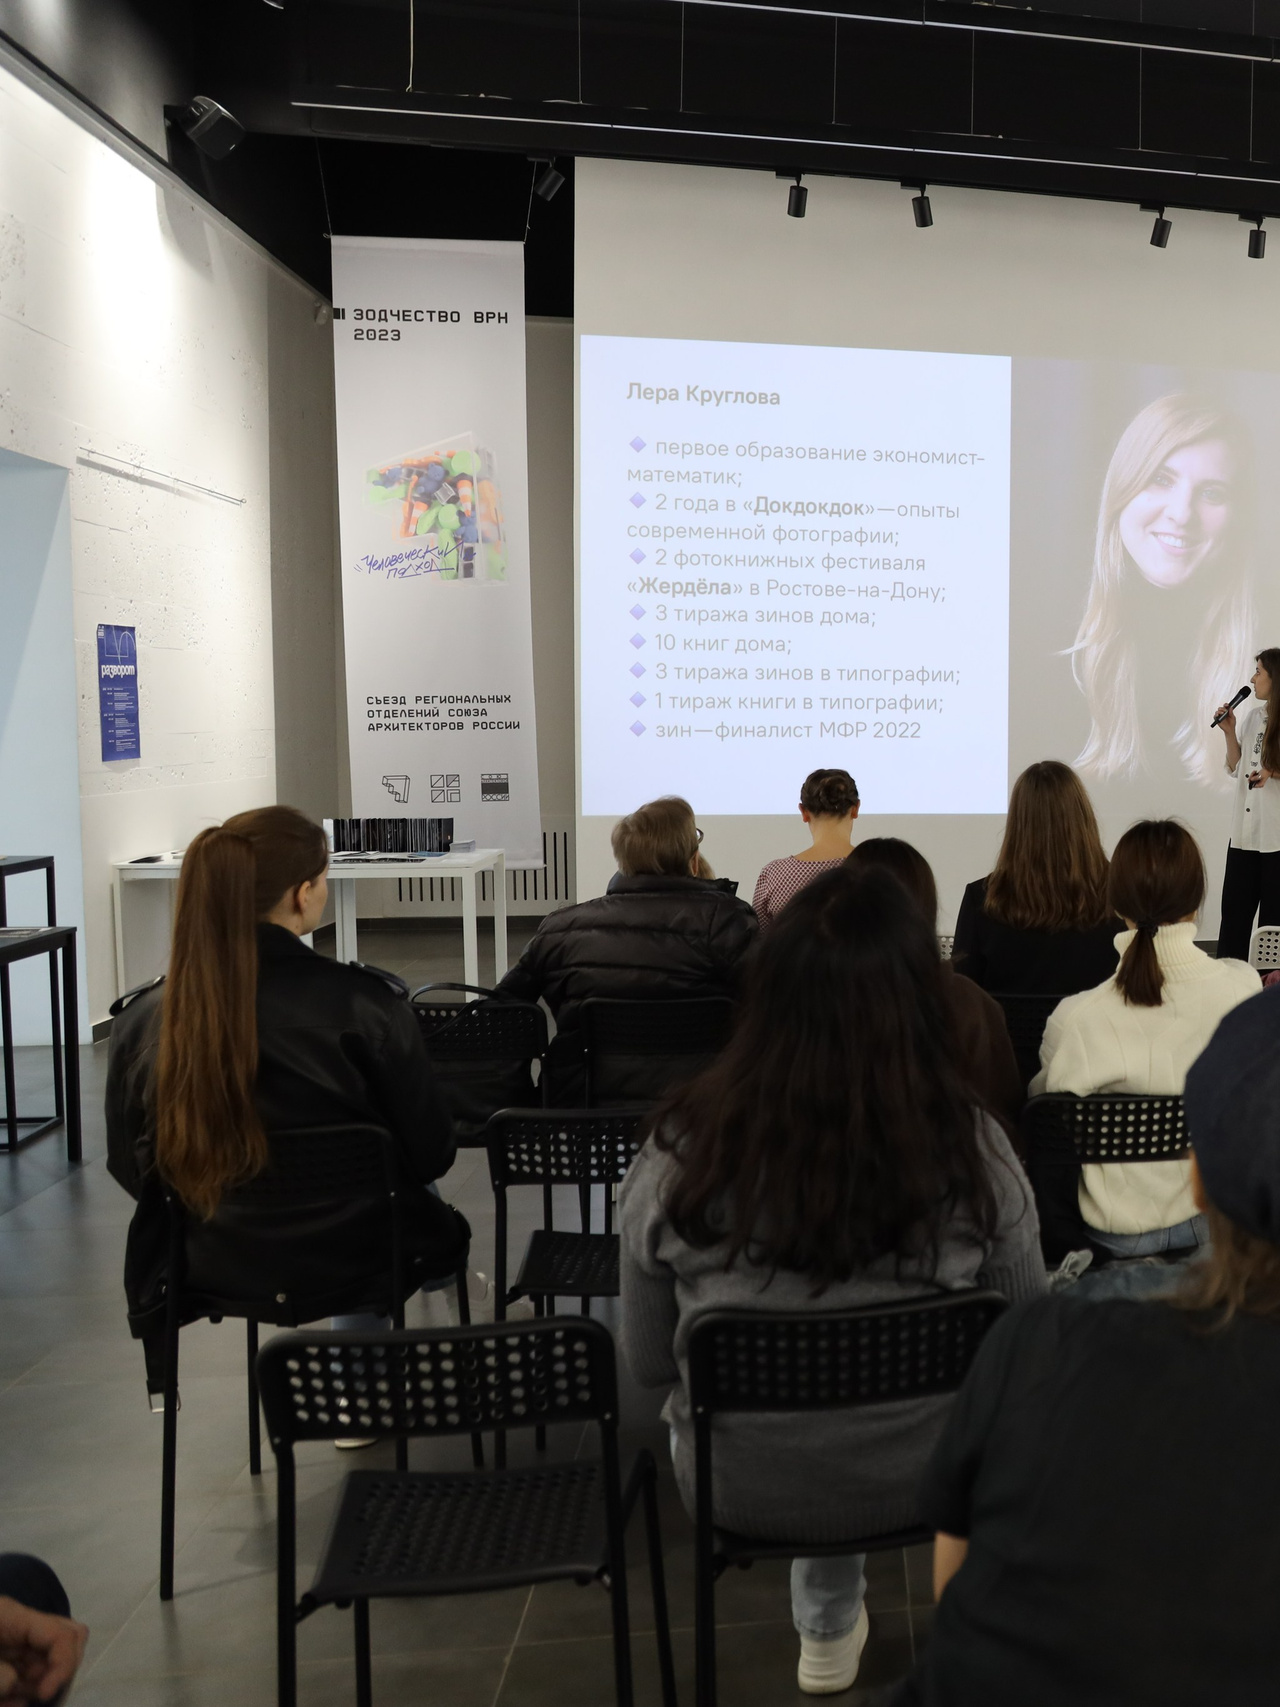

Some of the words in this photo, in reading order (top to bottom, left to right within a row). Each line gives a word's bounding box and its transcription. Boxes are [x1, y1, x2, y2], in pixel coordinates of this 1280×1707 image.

[353, 308, 461, 323] ЗОДЧЕСТВО
[473, 311, 508, 324] ВРН
[353, 328, 401, 342] 2023
[626, 381, 680, 405] Лера
[686, 384, 781, 407] Круглова
[656, 441, 729, 460] первое
[735, 440, 867, 462] образование
[872, 449, 985, 466] экономист-
[627, 468, 742, 489] математик;
[655, 492, 668, 511] 2
[674, 497, 719, 515] года
[725, 499, 737, 512] в
[626, 523, 766, 543] современной
[772, 524, 899, 548] фотографии;
[655, 548, 667, 566] 2
[673, 548, 815, 570] фотокнижных
[821, 552, 926, 573] фестиваля
[627, 576, 743, 599] «Жердёла»
[749, 582, 760, 596] в
[767, 578, 946, 604] Ростове-на-Дону;
[655, 603, 668, 622] 3
[673, 608, 749, 626] тиража
[755, 609, 814, 624] зинов
[819, 610, 876, 628] дома;
[655, 633, 676, 651] 10
[683, 638, 730, 652] книг
[734, 638, 792, 656] дома;
[655, 662, 668, 680] 3
[673, 666, 748, 685] тиража
[755, 667, 814, 681] зинов
[820, 668, 831, 681] в
[836, 665, 960, 686] типографии;
[366, 695, 407, 706] СЪЕЗД
[415, 694, 512, 705] РЕГИОНАЛЬНЫХ
[654, 691, 662, 709] 1
[668, 695, 732, 714] тираж
[738, 696, 796, 710] книги
[802, 697, 813, 710] в
[819, 693, 943, 715] типографии;
[367, 706, 440, 719] ОТДЕЛЕНИЙ
[447, 707, 488, 718] СОЮЗА
[367, 721, 465, 732] АРХИТЕКТОРОВ
[472, 720, 521, 730] РОССИИ
[819, 721, 868, 738] МФР
[873, 721, 921, 739] 2022
